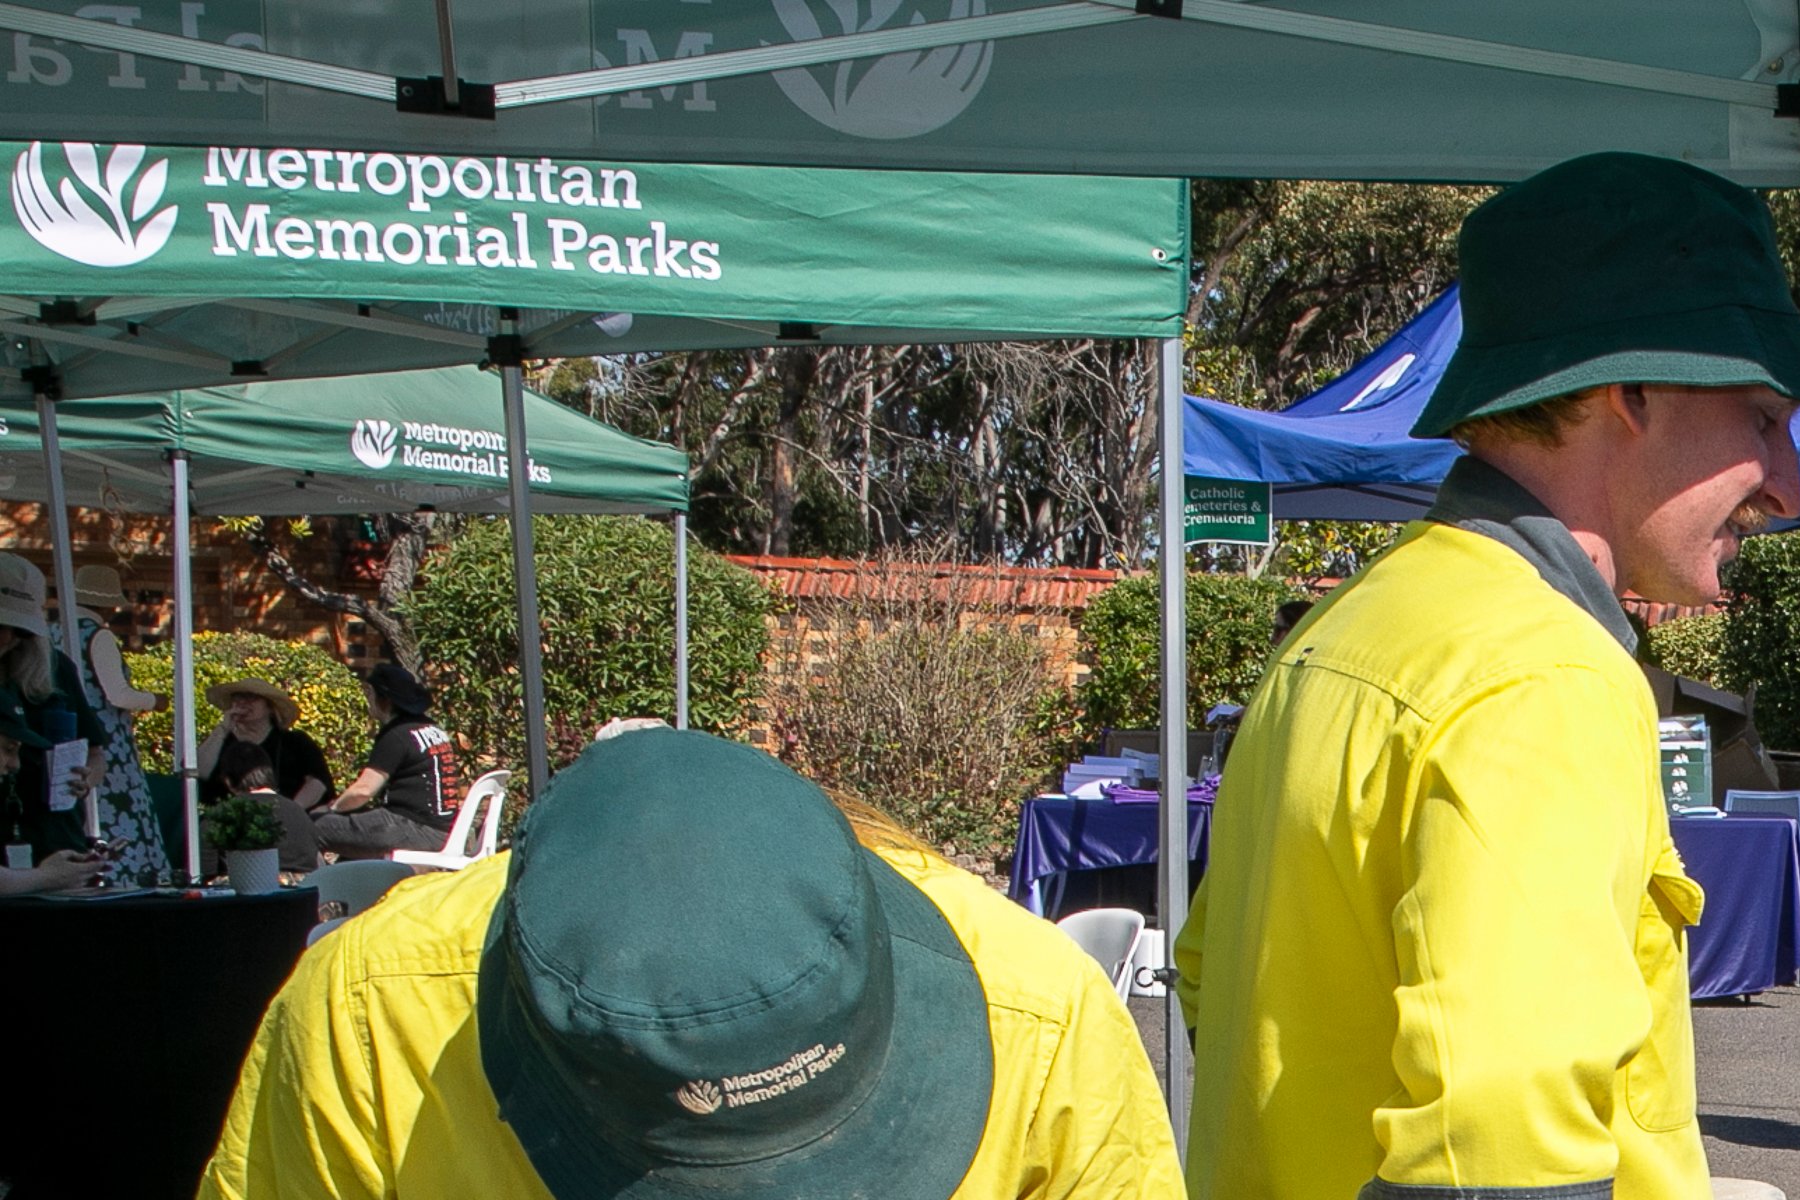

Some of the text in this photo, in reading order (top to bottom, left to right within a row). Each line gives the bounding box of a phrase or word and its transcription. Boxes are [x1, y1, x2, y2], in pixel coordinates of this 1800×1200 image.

[203, 147, 643, 211] Metropolitan
[206, 202, 722, 281] Memorial Parks
[403, 445, 496, 478] Memorial
[1184, 500, 1262, 514] emeteries &
[1190, 487, 1246, 500] Catholic
[1184, 513, 1256, 527] Crematoria
[721, 1043, 826, 1092] Metropolitan
[726, 1042, 847, 1108] Memorial Parks
